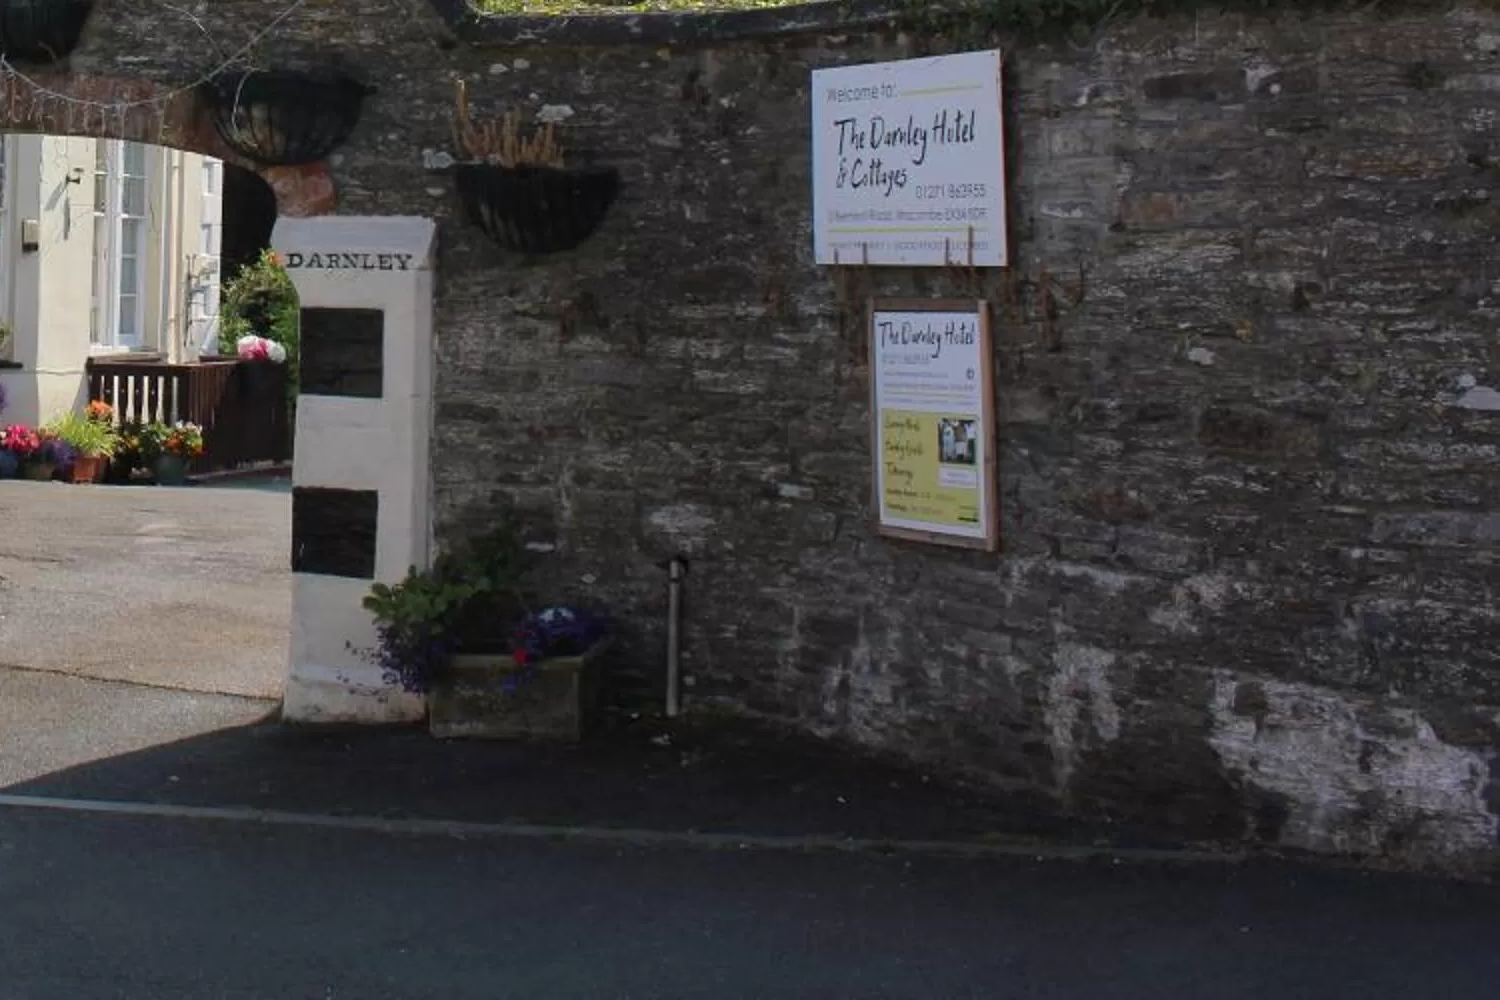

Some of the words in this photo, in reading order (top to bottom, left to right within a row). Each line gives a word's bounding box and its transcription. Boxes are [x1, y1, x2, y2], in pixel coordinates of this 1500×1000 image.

[828, 85, 879, 103] Welcome
[833, 117, 866, 156] The
[869, 114, 928, 166] Darnley
[931, 108, 976, 145] Hotel
[835, 157, 849, 190] &
[850, 157, 908, 197] Cottages
[915, 184, 945, 199] 01271
[285, 251, 413, 271] DARNLEY
[878, 321, 899, 350] The
[900, 320, 942, 359] Darnley
[943, 320, 975, 345] Hotel
